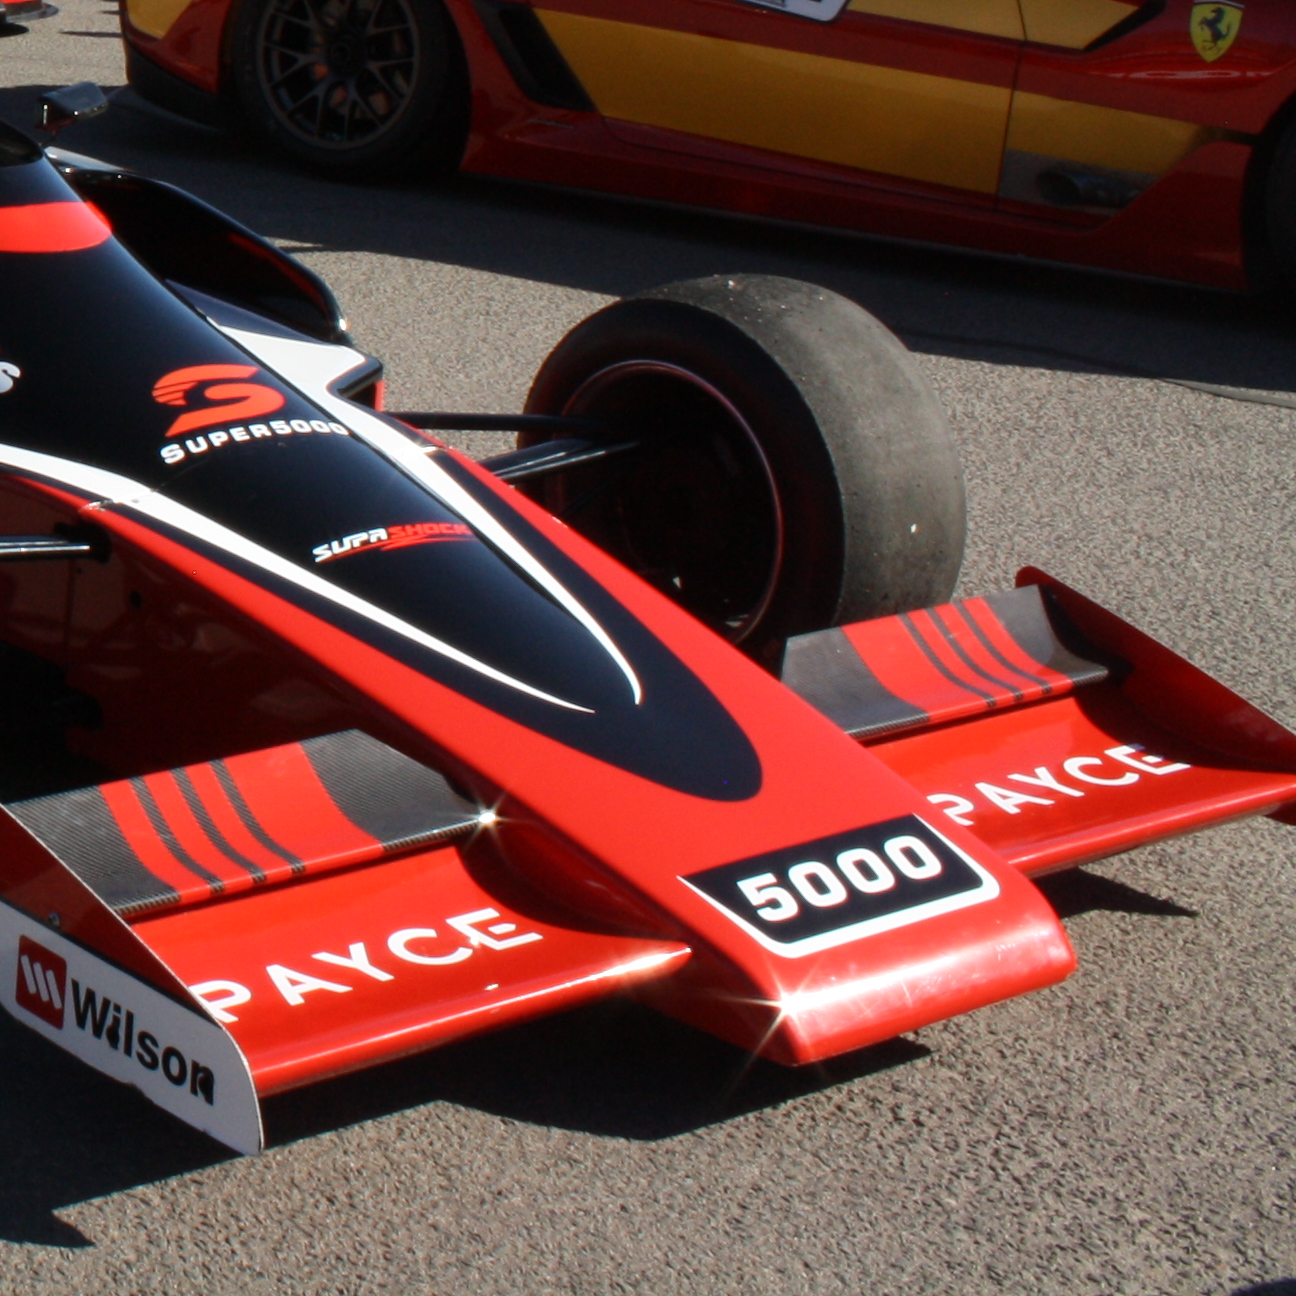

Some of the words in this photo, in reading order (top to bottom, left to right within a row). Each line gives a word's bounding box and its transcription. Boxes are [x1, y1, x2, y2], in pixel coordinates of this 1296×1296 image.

[160, 419, 350, 465] SUPER5000
[927, 743, 1192, 826] PAYCE
[736, 834, 944, 923] 5000
[186, 907, 545, 1025] PAYCE
[70, 979, 217, 1107] Wilson
